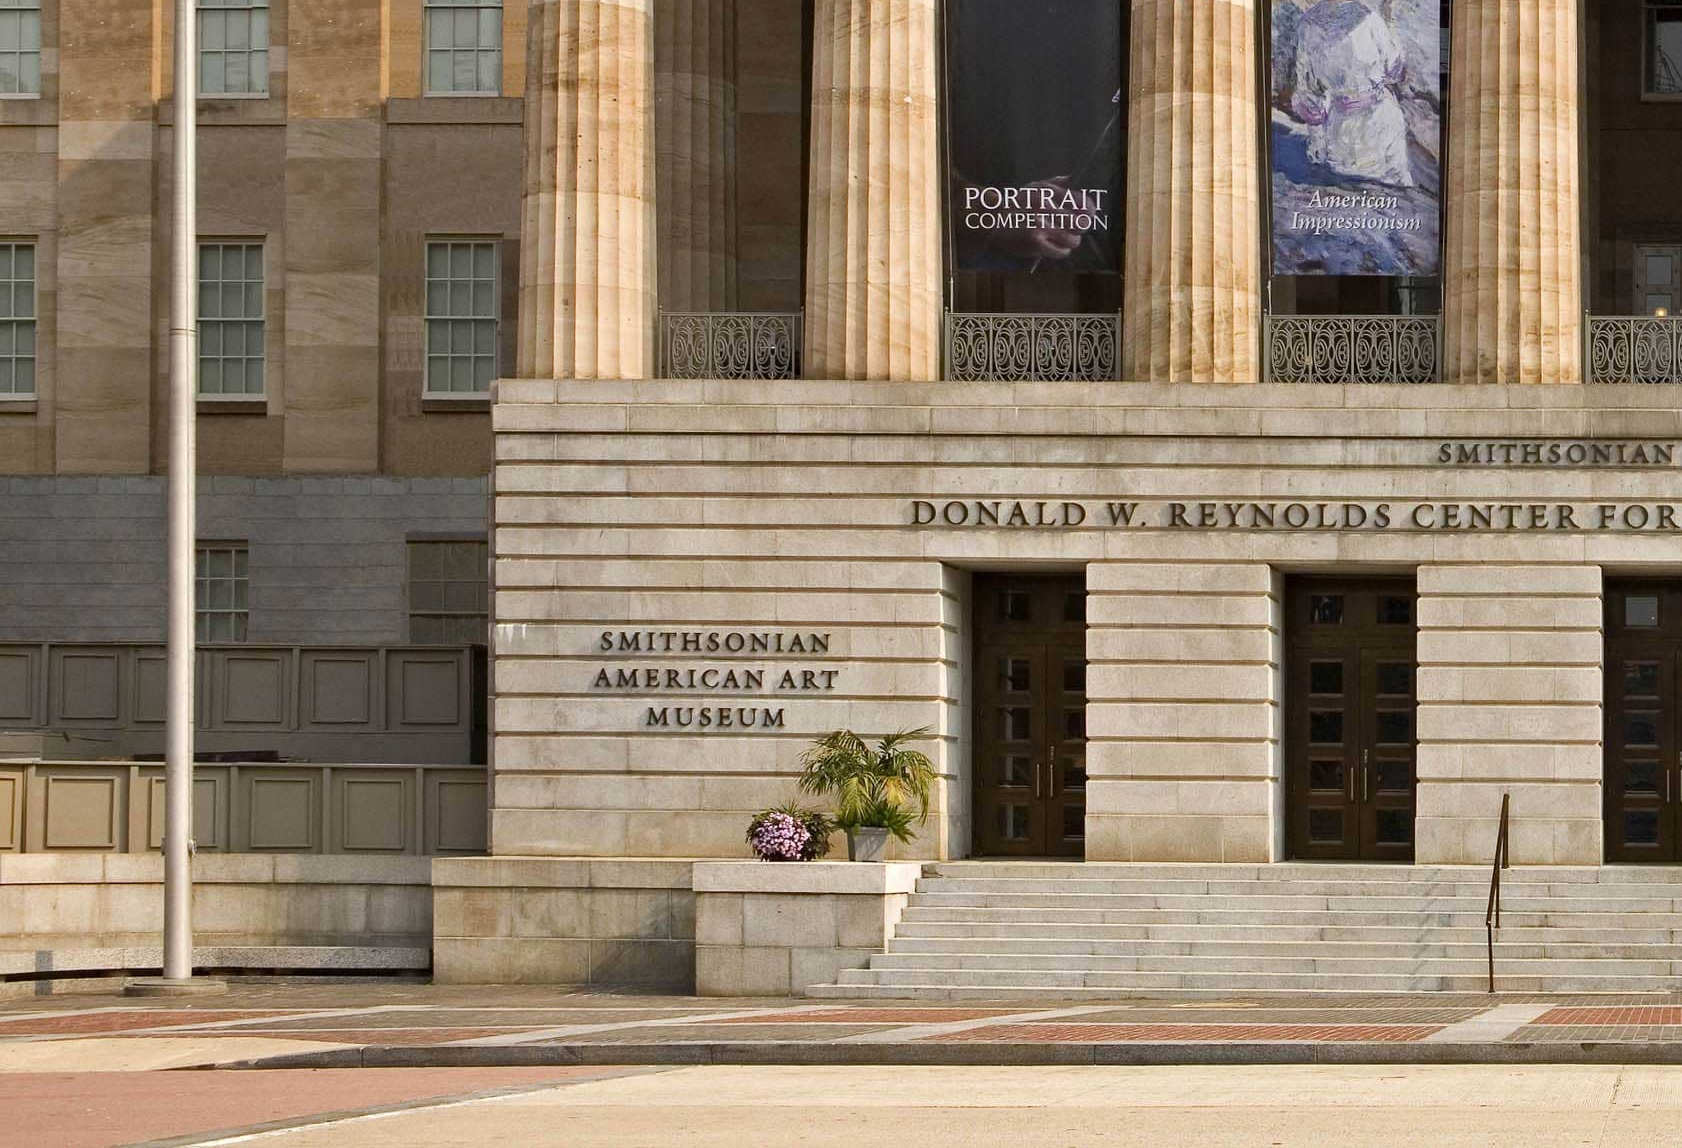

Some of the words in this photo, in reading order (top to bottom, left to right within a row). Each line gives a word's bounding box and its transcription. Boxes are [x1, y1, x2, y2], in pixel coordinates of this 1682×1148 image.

[965, 187, 1108, 211] PORTRAIT
[1308, 190, 1400, 209] American
[965, 212, 1108, 230] COMPETITION
[1291, 211, 1422, 236] Impressionism
[1438, 443, 1675, 465] SMITHSONIAN
[911, 500, 1086, 526] DONALD
[1106, 502, 1147, 527] W.
[1168, 502, 1391, 528] REYNOLDS
[1411, 504, 1580, 530] CENTER
[1598, 504, 1682, 530] FOR
[600, 631, 831, 653] SMITHSONIAN
[594, 667, 765, 689] AMERICAN
[778, 669, 839, 689] ART
[646, 707, 786, 727] MUSEUM
